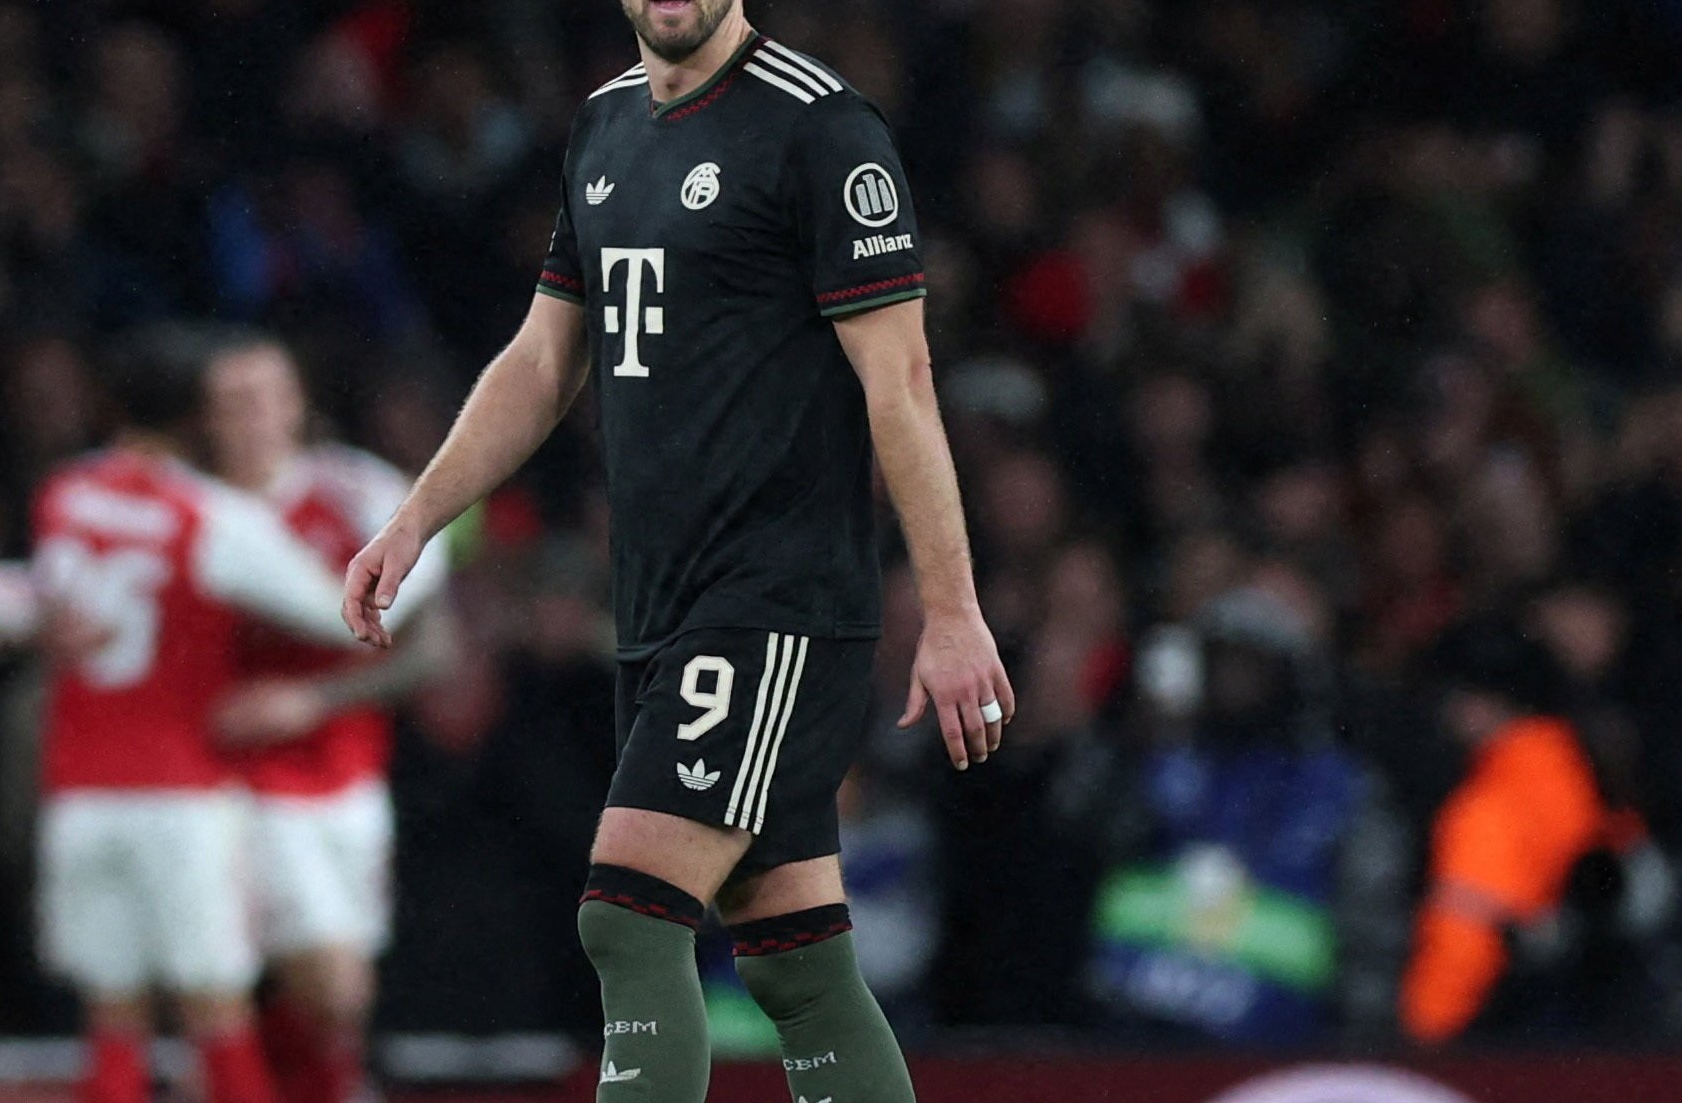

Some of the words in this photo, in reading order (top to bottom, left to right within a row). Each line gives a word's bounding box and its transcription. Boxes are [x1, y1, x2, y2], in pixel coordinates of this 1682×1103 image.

[852, 233, 914, 261] Allianz
[601, 247, 665, 377] T
[676, 654, 736, 742] 9
